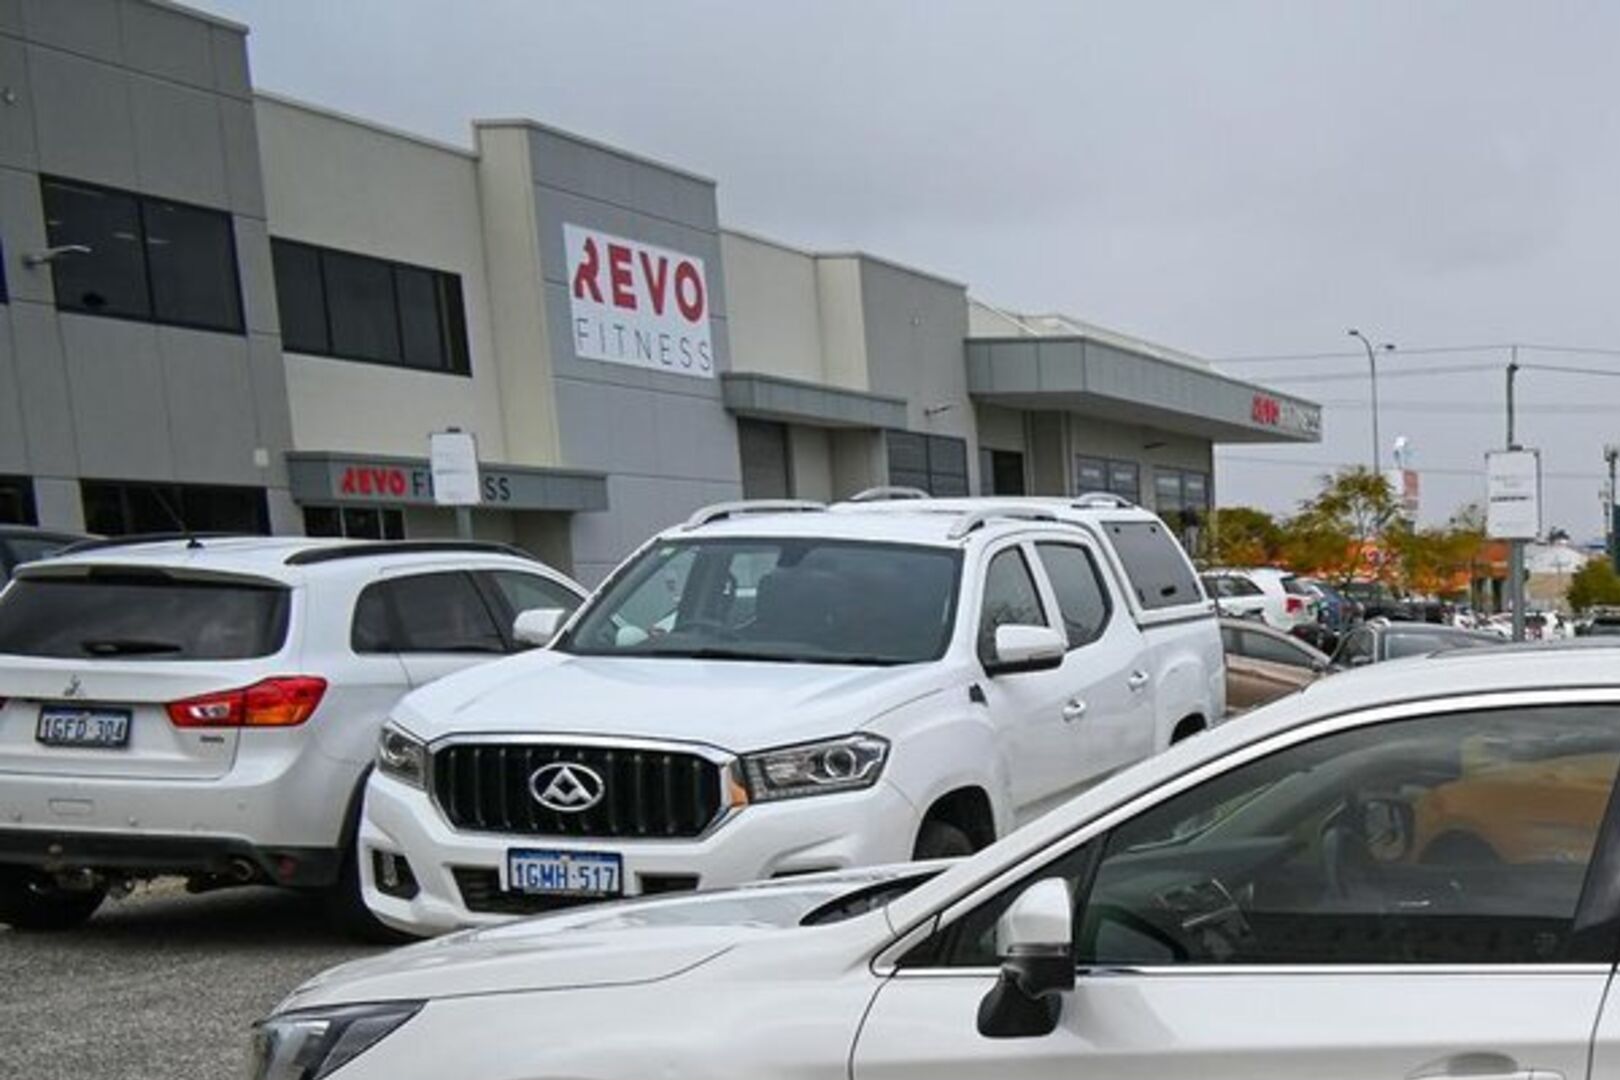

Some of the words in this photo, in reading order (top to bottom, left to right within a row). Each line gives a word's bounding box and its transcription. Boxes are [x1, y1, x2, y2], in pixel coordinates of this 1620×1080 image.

[574, 237, 704, 323] REVO
[576, 317, 711, 371] FITNESS
[342, 466, 408, 496] REVO
[412, 471, 511, 500] FISS
